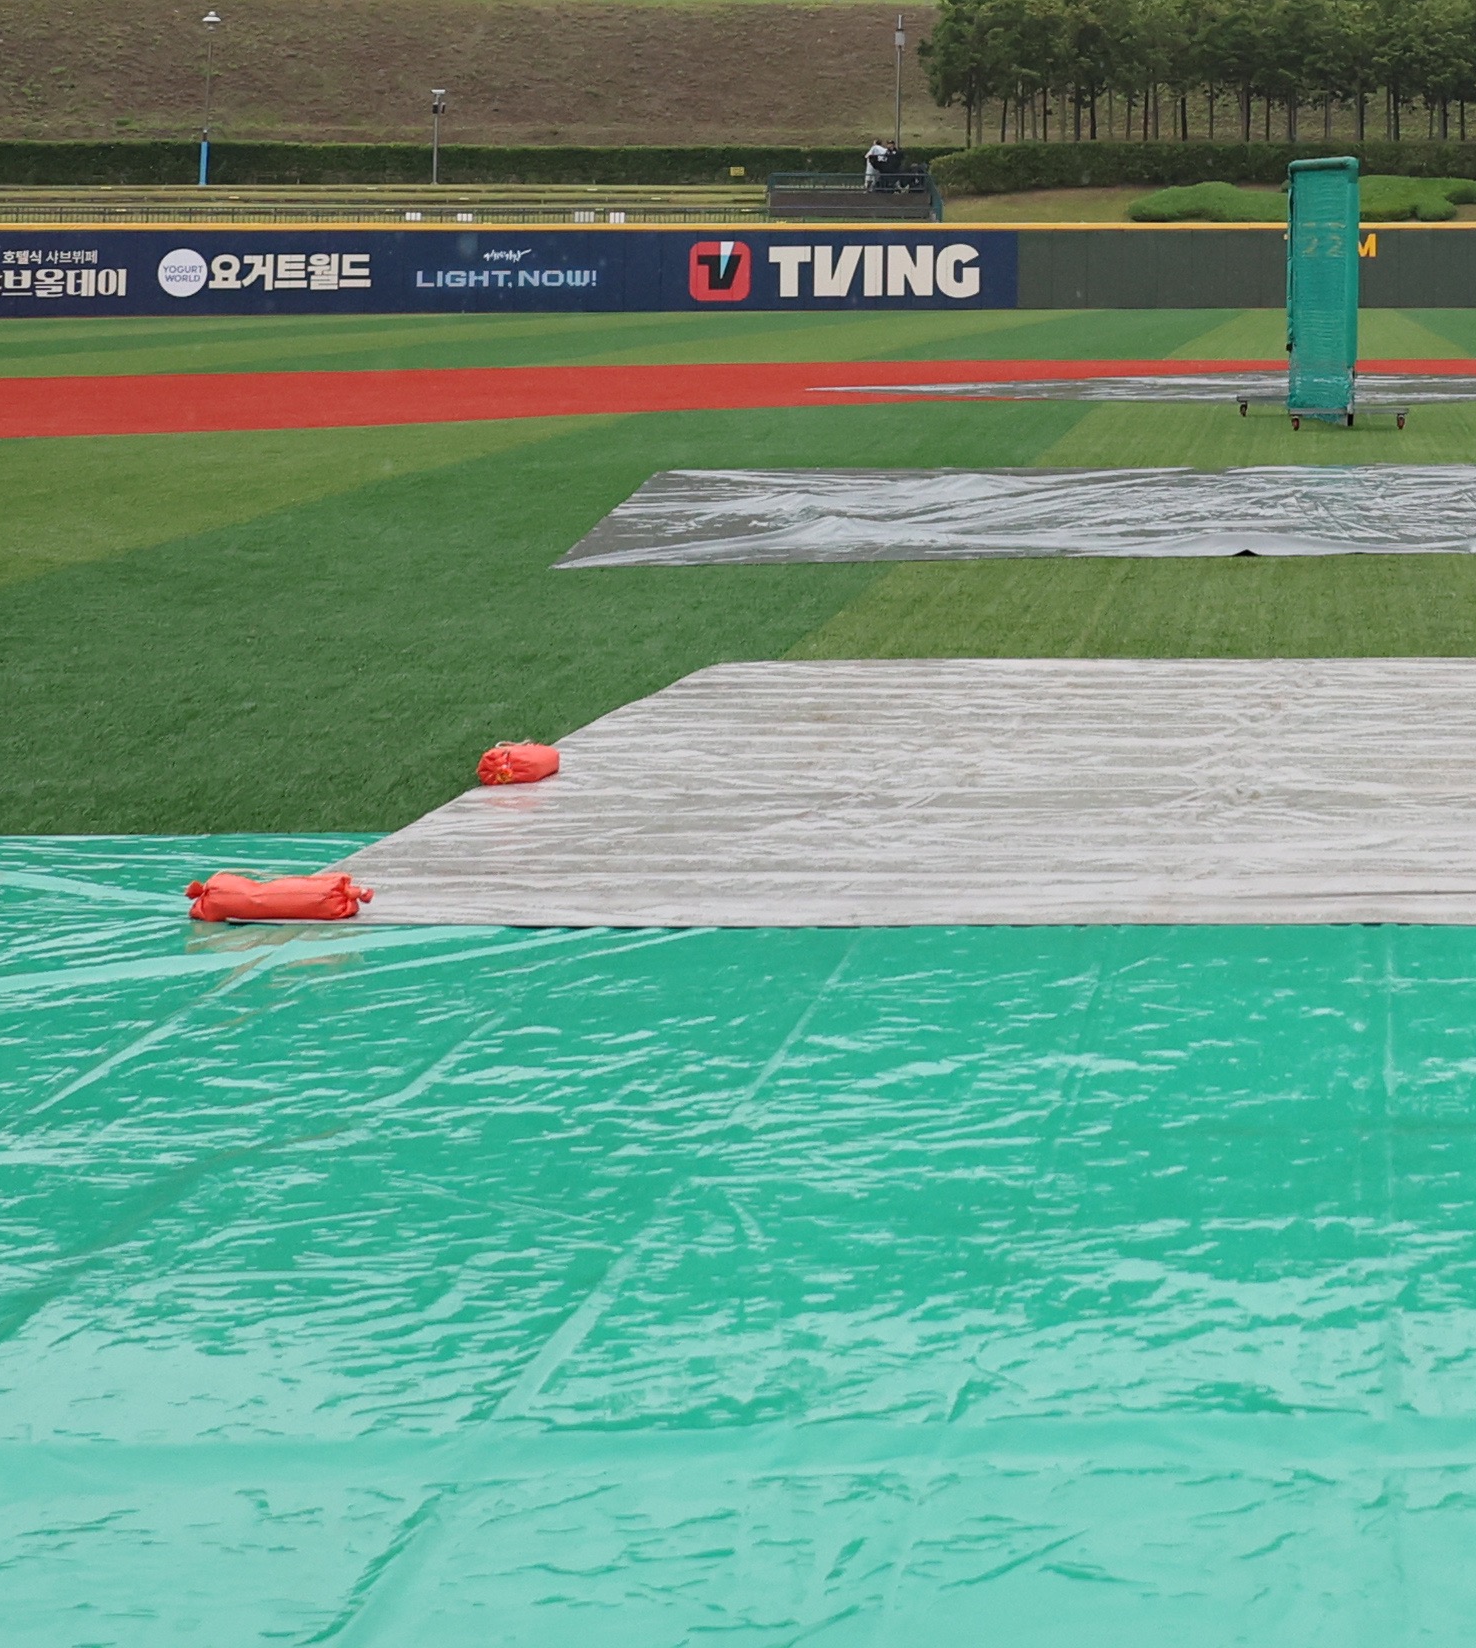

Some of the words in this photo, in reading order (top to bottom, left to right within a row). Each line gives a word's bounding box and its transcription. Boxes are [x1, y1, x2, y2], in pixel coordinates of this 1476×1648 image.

[2, 249, 43, 265] 호텔식
[45, 249, 99, 265] 샤브뷔페
[163, 264, 204, 274] YOGURT
[208, 253, 372, 291] 요거트월드
[768, 243, 980, 298] TVING
[165, 274, 201, 283] WORLD
[416, 270, 513, 289] LIGHT,
[517, 269, 597, 287] NOW!
